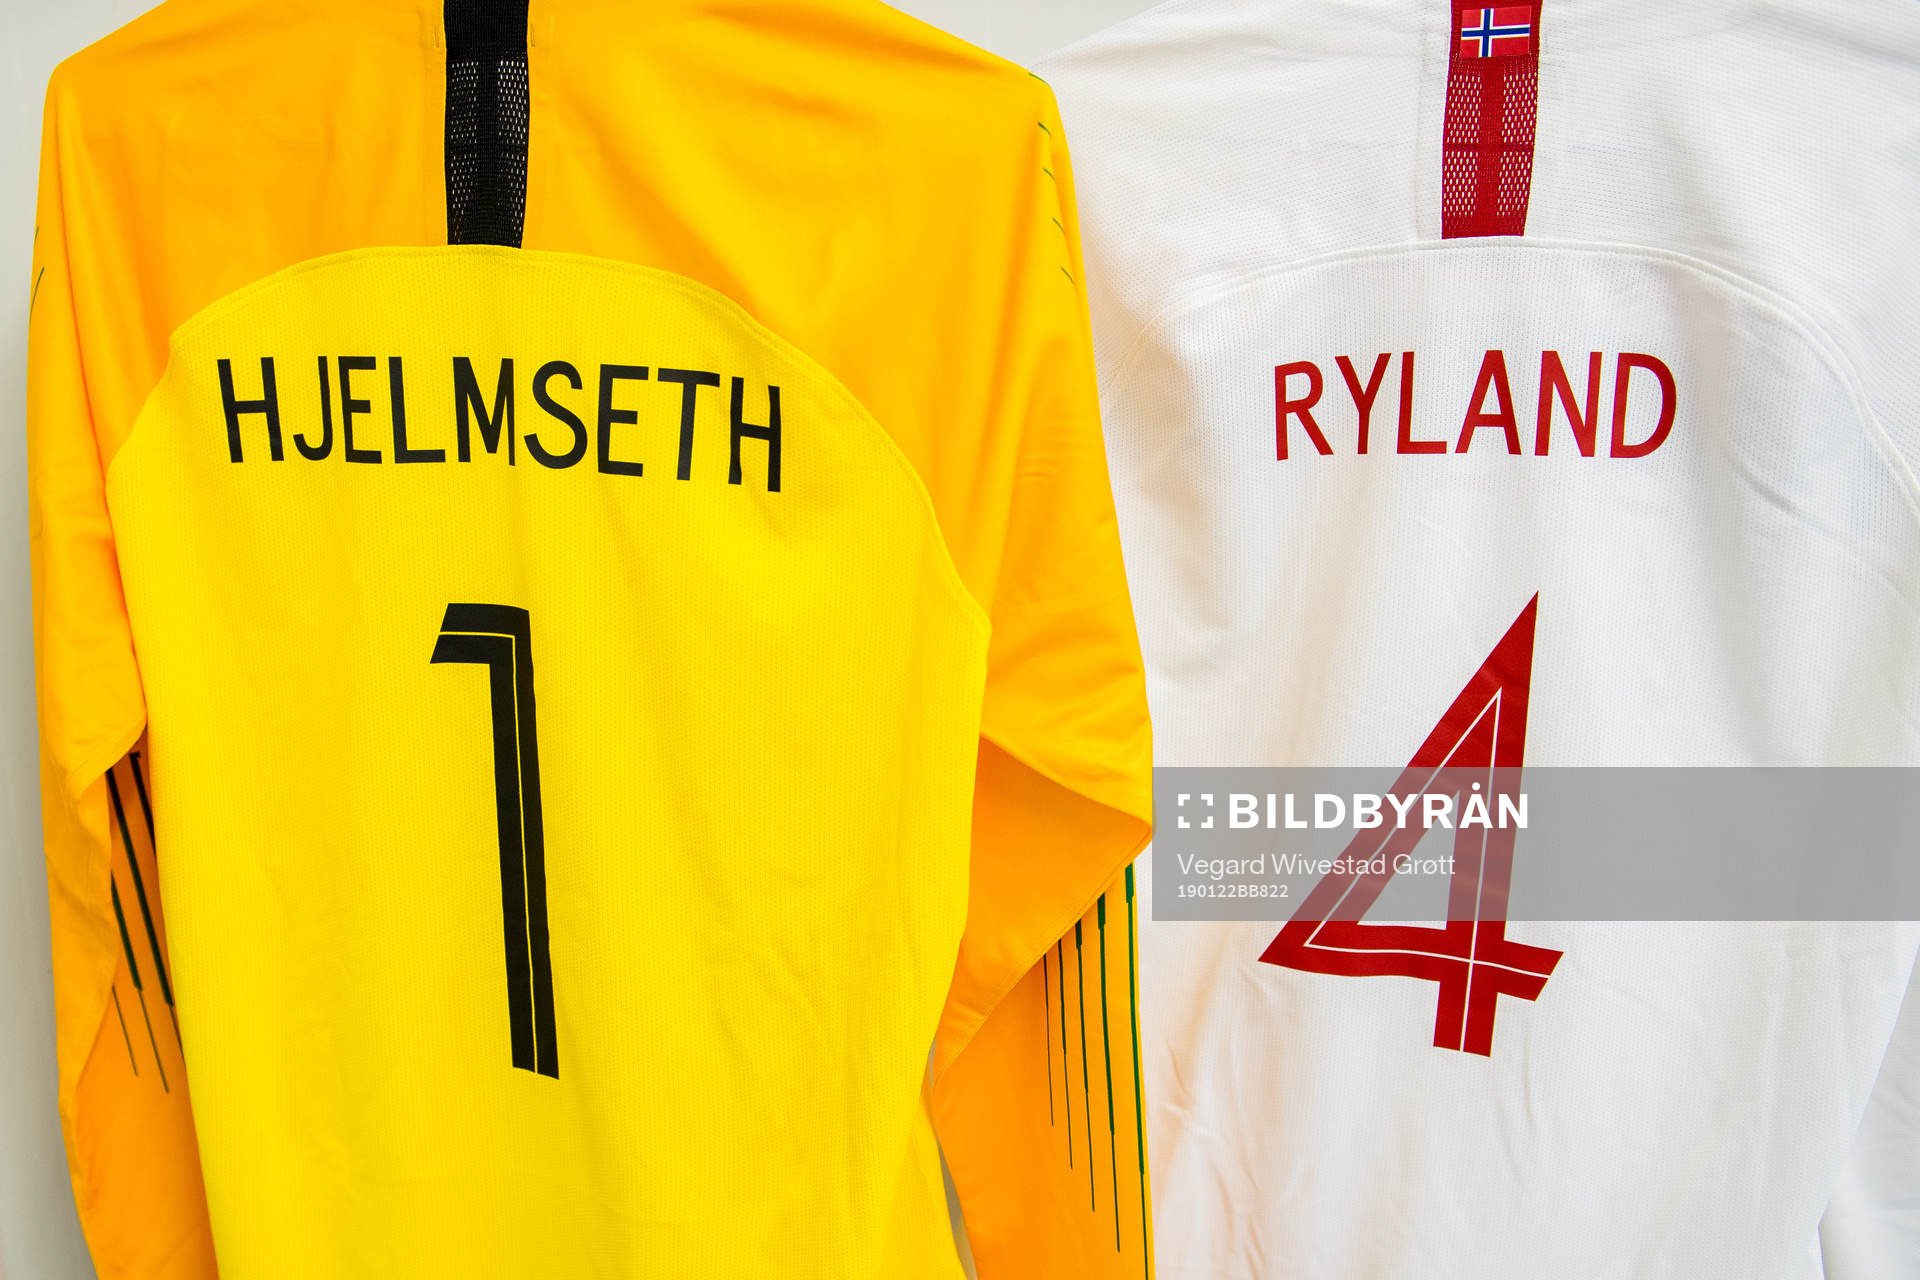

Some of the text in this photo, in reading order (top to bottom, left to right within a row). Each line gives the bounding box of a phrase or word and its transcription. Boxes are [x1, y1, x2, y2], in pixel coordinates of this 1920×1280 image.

[216, 355, 782, 494] HJELMSETH
[1274, 349, 1678, 462] RYLAND
[429, 602, 560, 1080] 1
[1258, 591, 1564, 1057] 4
